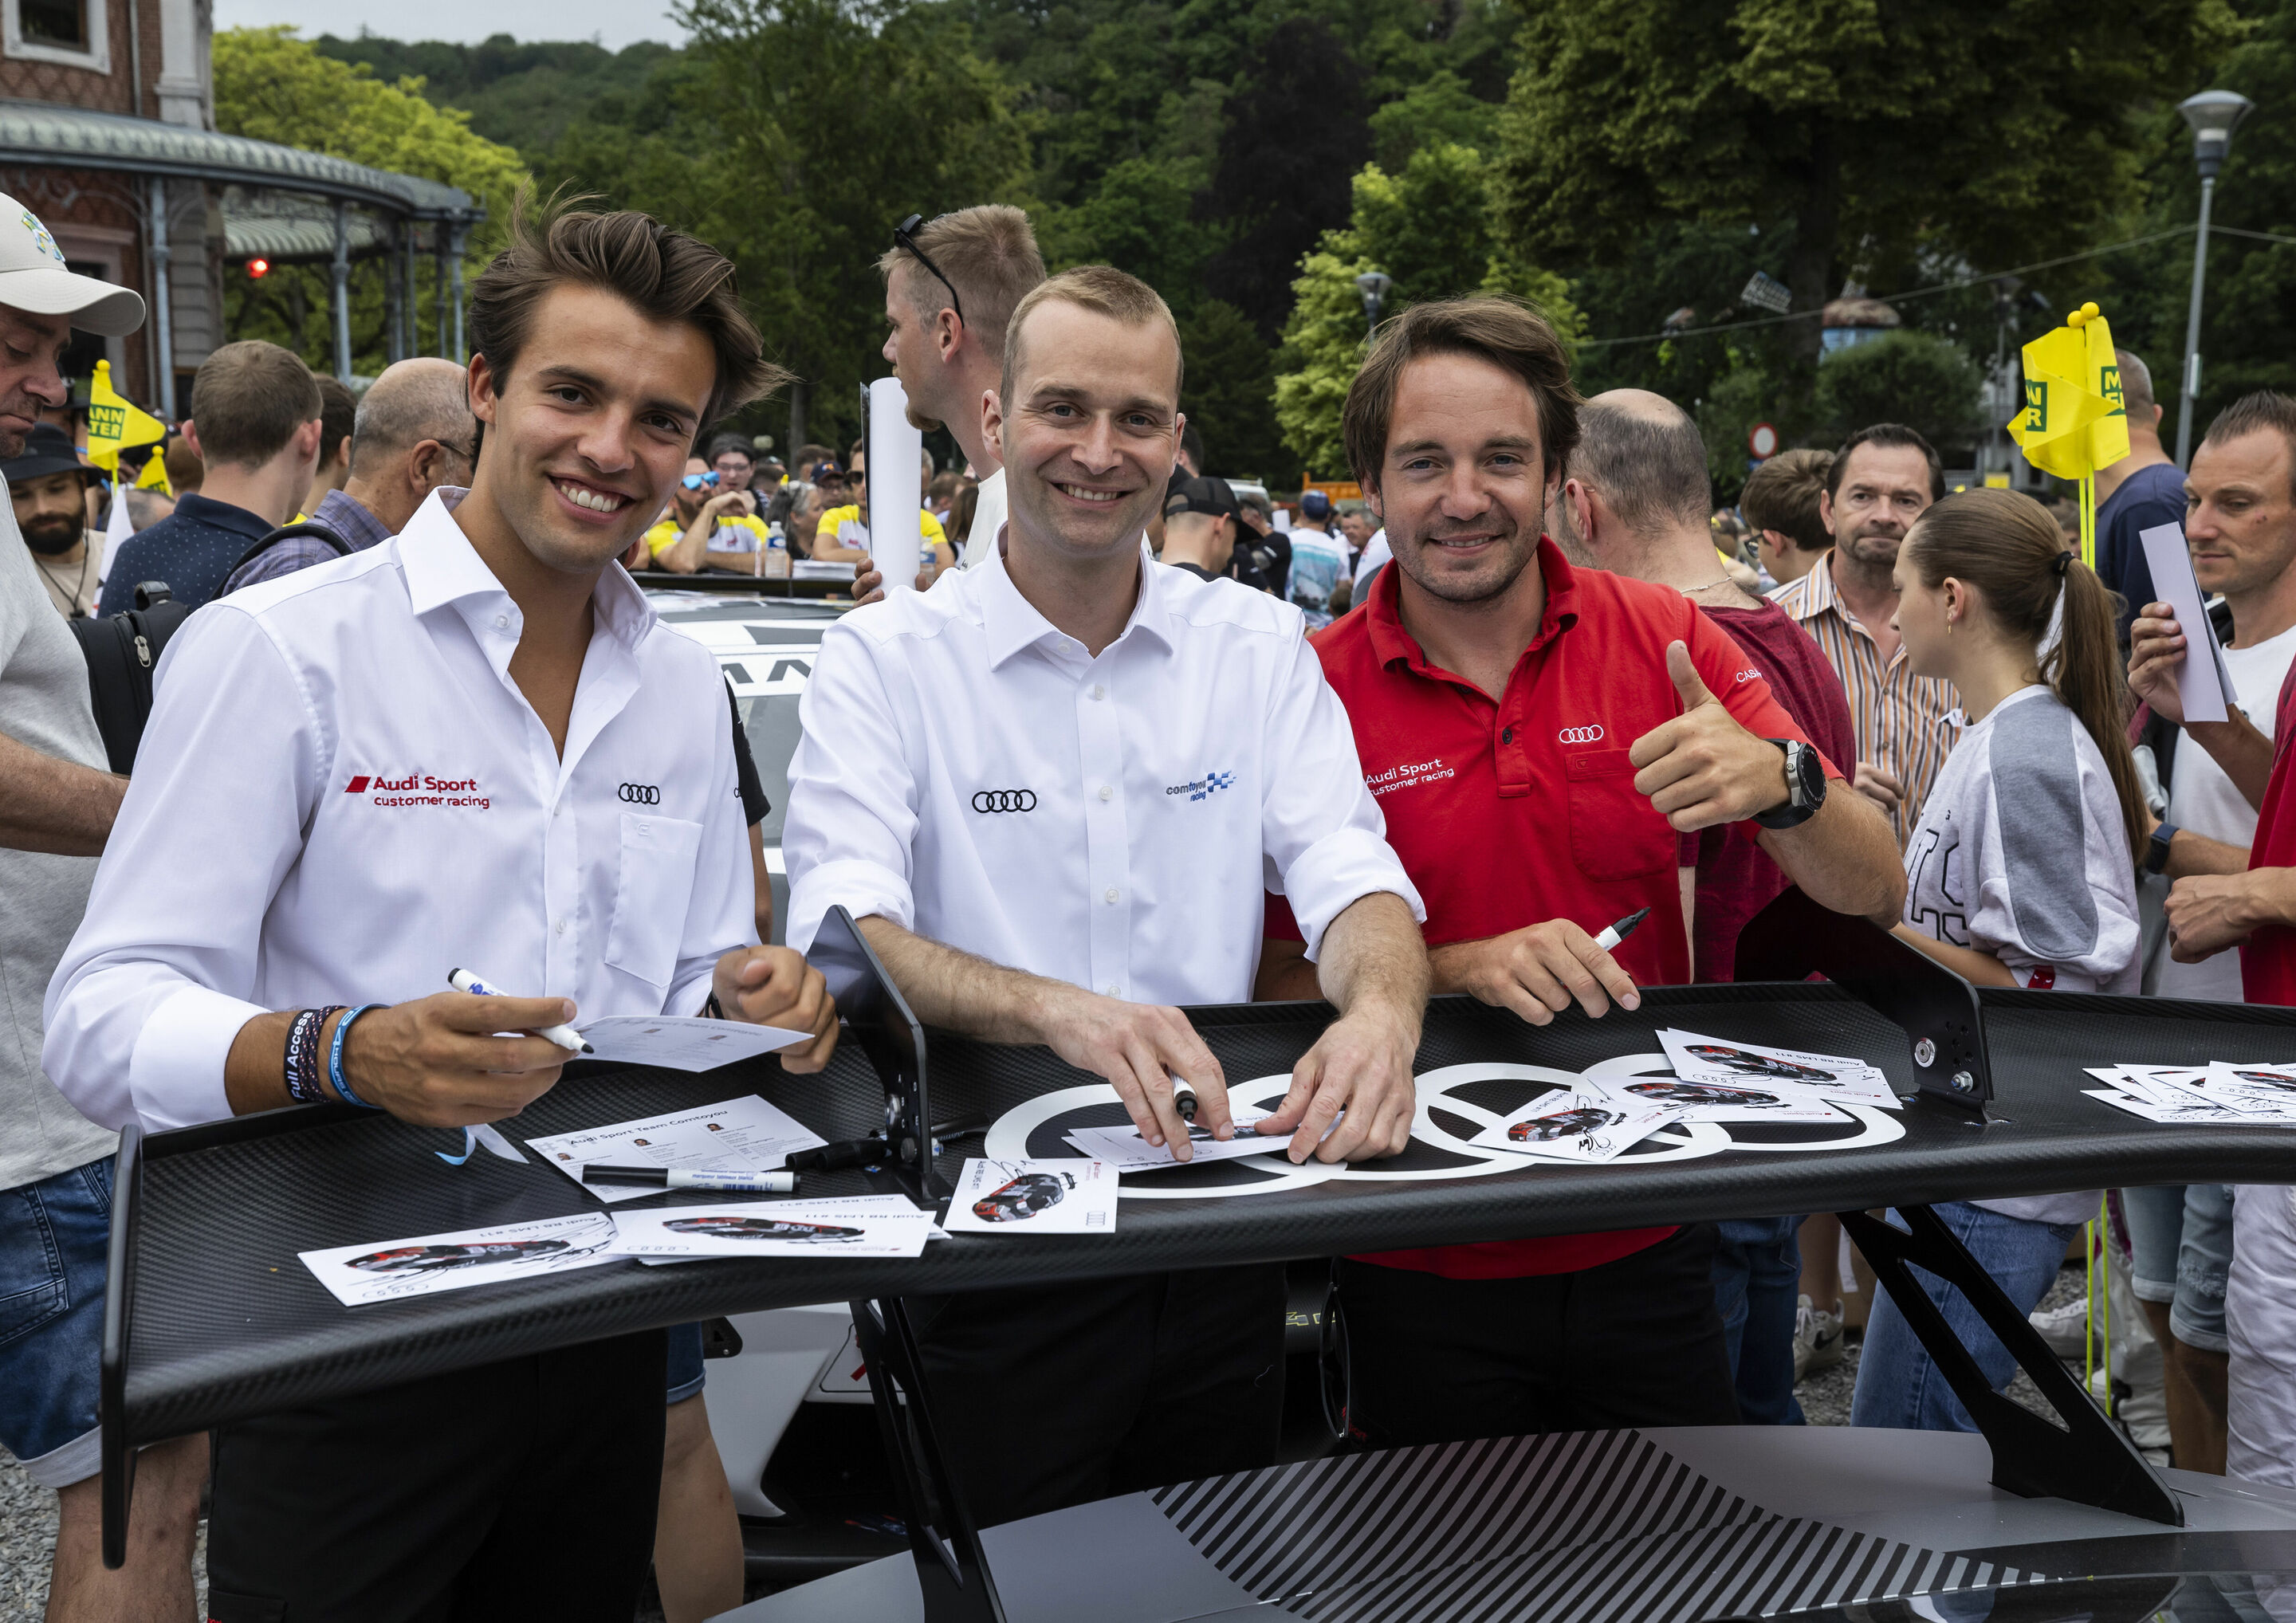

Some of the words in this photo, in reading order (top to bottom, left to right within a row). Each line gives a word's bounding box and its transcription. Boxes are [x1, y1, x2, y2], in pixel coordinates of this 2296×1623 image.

[1365, 767, 1398, 785] Audi
[1399, 758, 1443, 776] Sport
[1421, 768, 1455, 783] racing
[373, 775, 419, 791] Audi
[424, 776, 478, 793] Sport
[1166, 780, 1207, 796] comtoyou
[374, 796, 444, 807] customer
[447, 796, 490, 810] racing
[1189, 790, 1206, 802] racing
[287, 1011, 313, 1068] Access
[287, 1070, 306, 1100] Full
[570, 1135, 598, 1146] Audi
[599, 1128, 635, 1140] Sport
[635, 1122, 668, 1133] Team
[669, 1109, 728, 1126] Comtoyou
